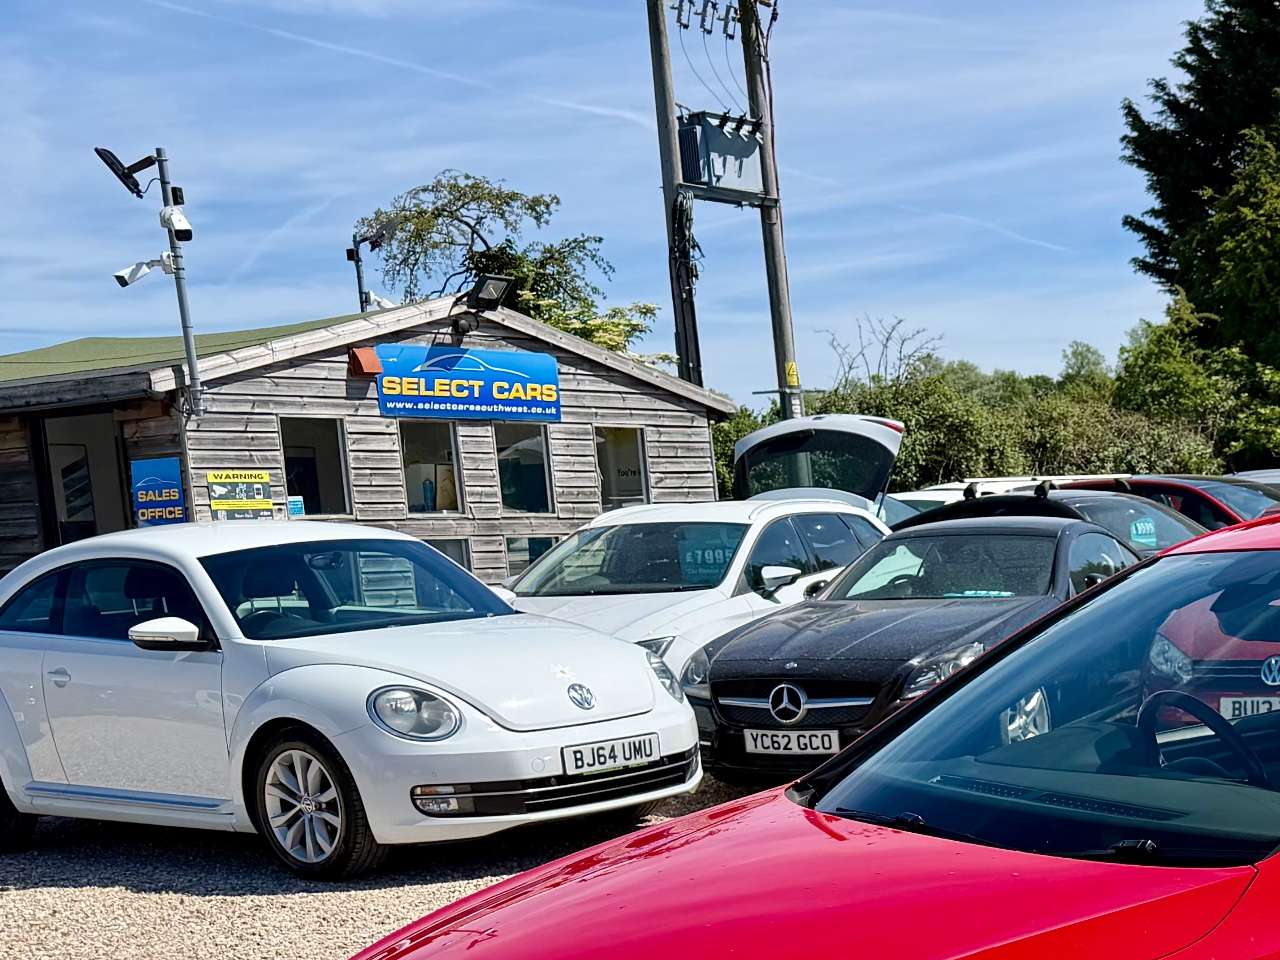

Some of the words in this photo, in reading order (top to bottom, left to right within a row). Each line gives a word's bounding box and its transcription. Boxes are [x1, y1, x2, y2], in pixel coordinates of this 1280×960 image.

[382, 376, 484, 398] SELECT
[492, 381, 557, 402] CARS
[138, 489, 179, 502] SALES
[138, 507, 183, 520] OFFICE
[750, 733, 793, 751] YC62
[796, 734, 832, 751] GCO
[573, 744, 617, 769] BJ64
[622, 738, 653, 761] UMU
